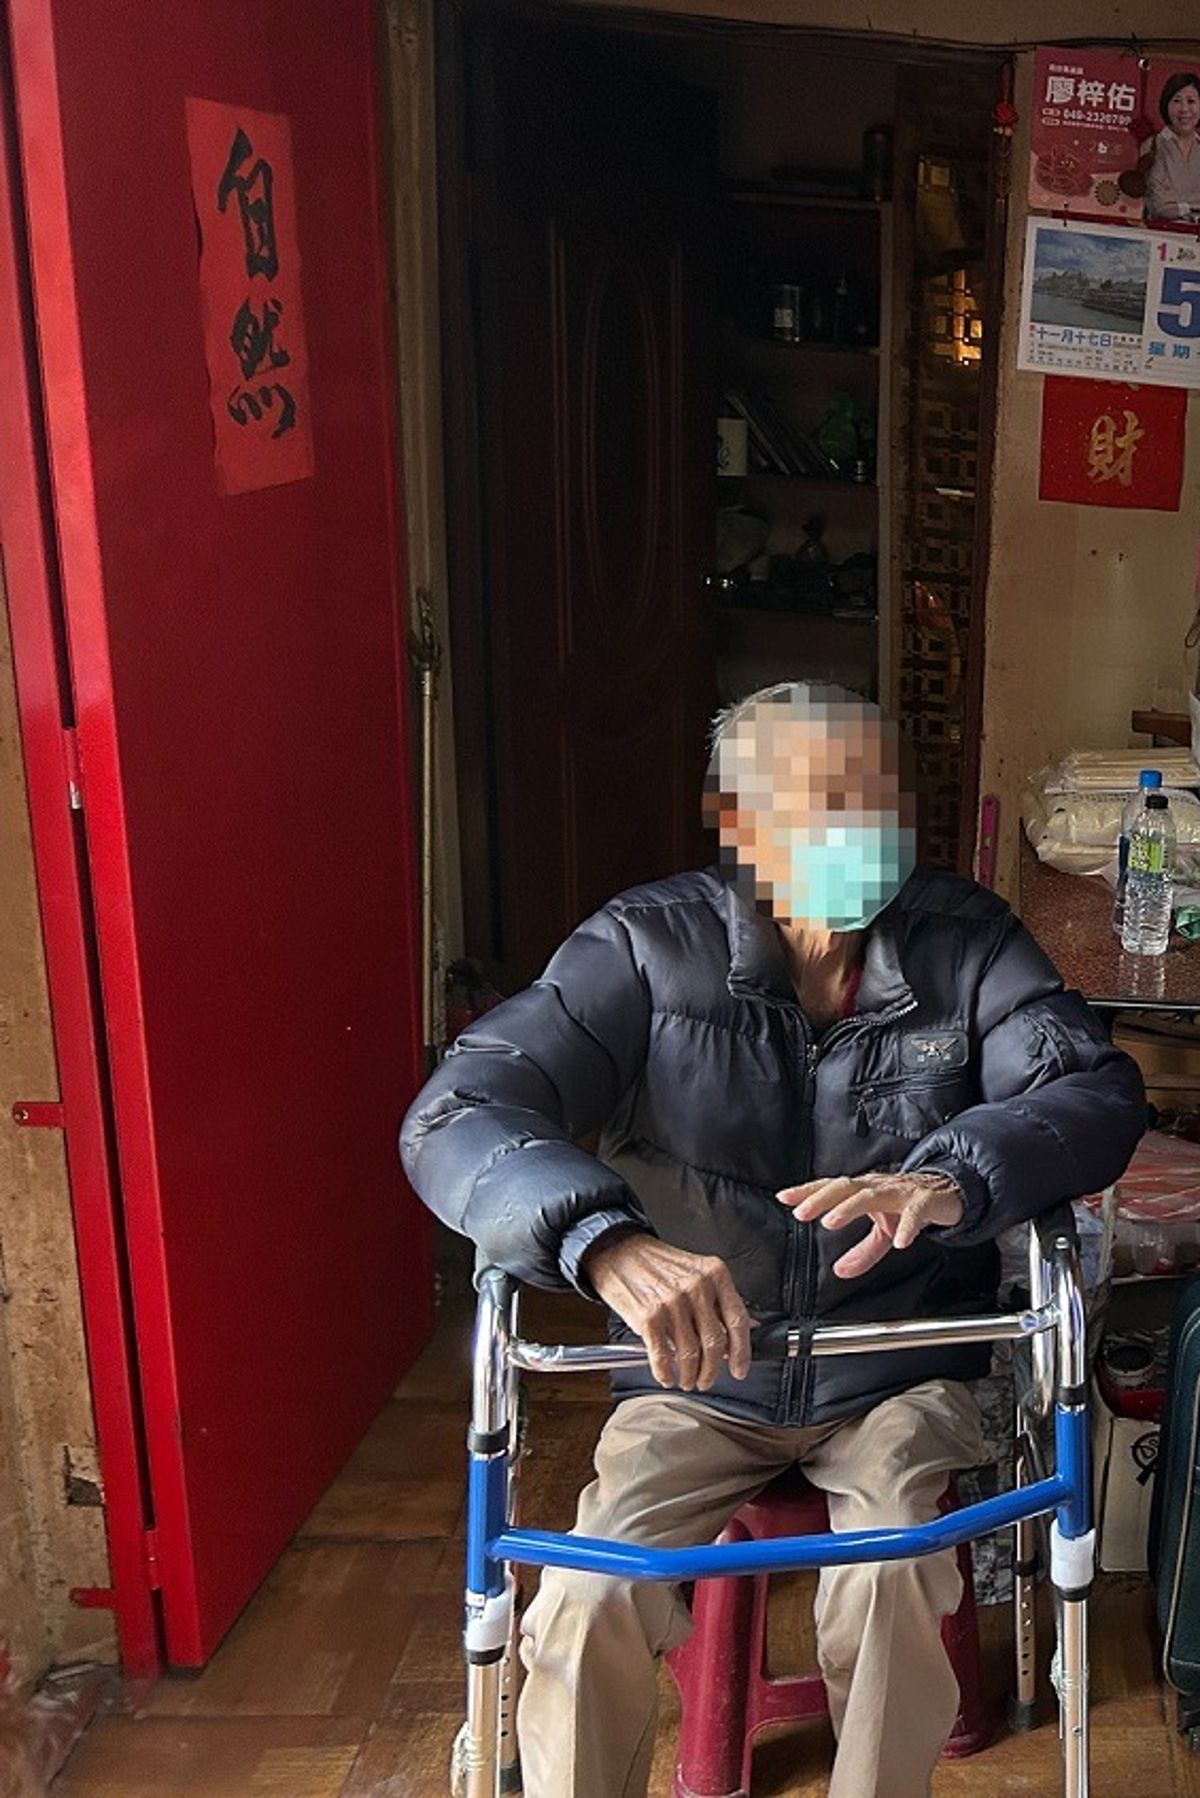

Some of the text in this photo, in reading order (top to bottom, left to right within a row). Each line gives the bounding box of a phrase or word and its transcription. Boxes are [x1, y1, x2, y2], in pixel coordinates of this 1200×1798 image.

[1045, 76, 1137, 112] 廖梓佑
[1037, 326, 1112, 348] 十一月十七日
[1087, 410, 1147, 487] 財
